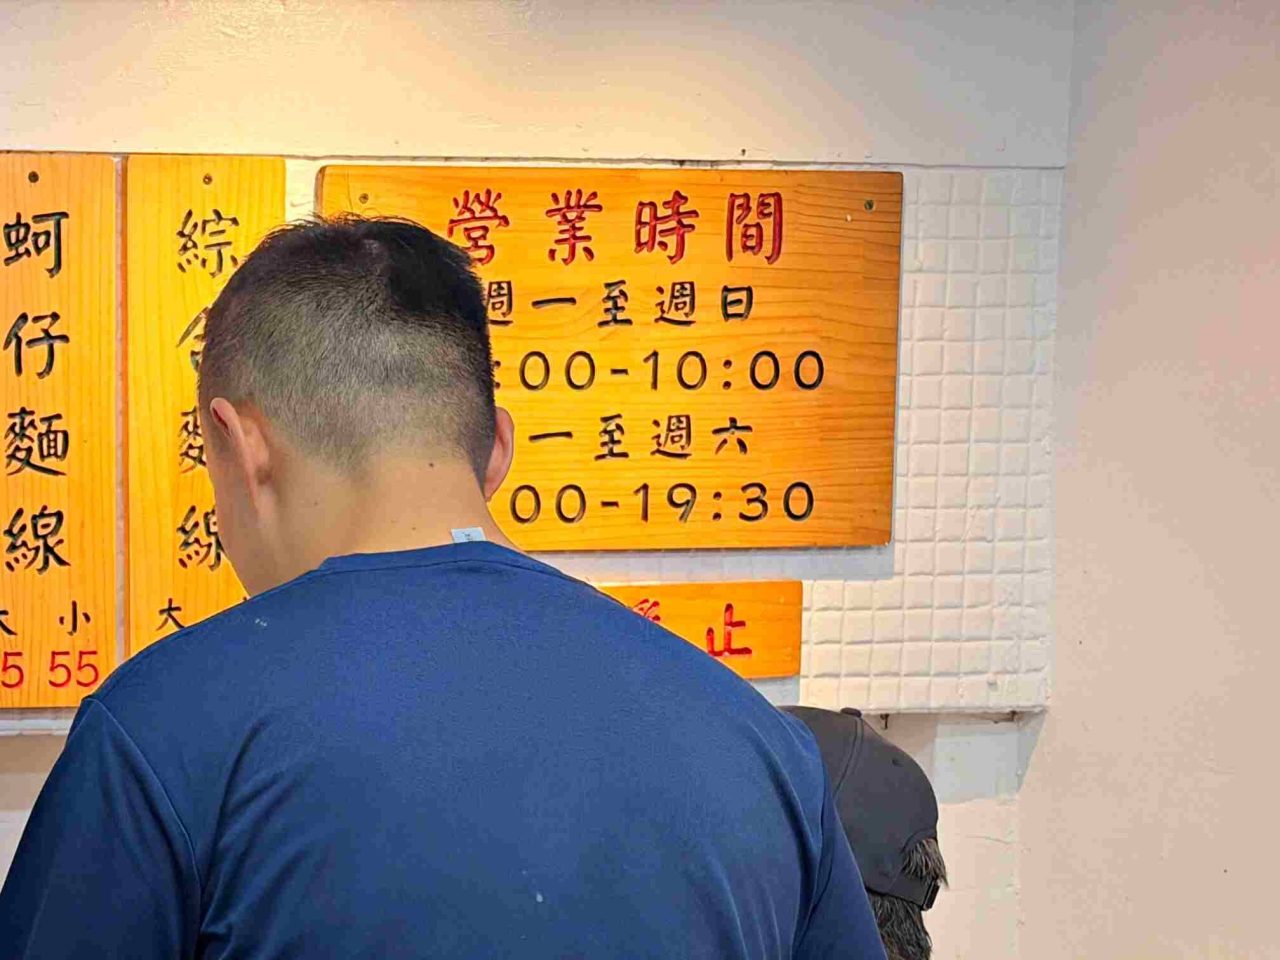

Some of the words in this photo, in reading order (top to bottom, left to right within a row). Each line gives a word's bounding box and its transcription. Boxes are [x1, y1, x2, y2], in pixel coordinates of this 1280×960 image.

[447, 187, 785, 266] 營業時間
[2, 210, 72, 575] 蚵仔麵線
[176, 208, 240, 573] 綜線
[58, 600, 92, 636] 小
[47, 649, 101, 690] 55
